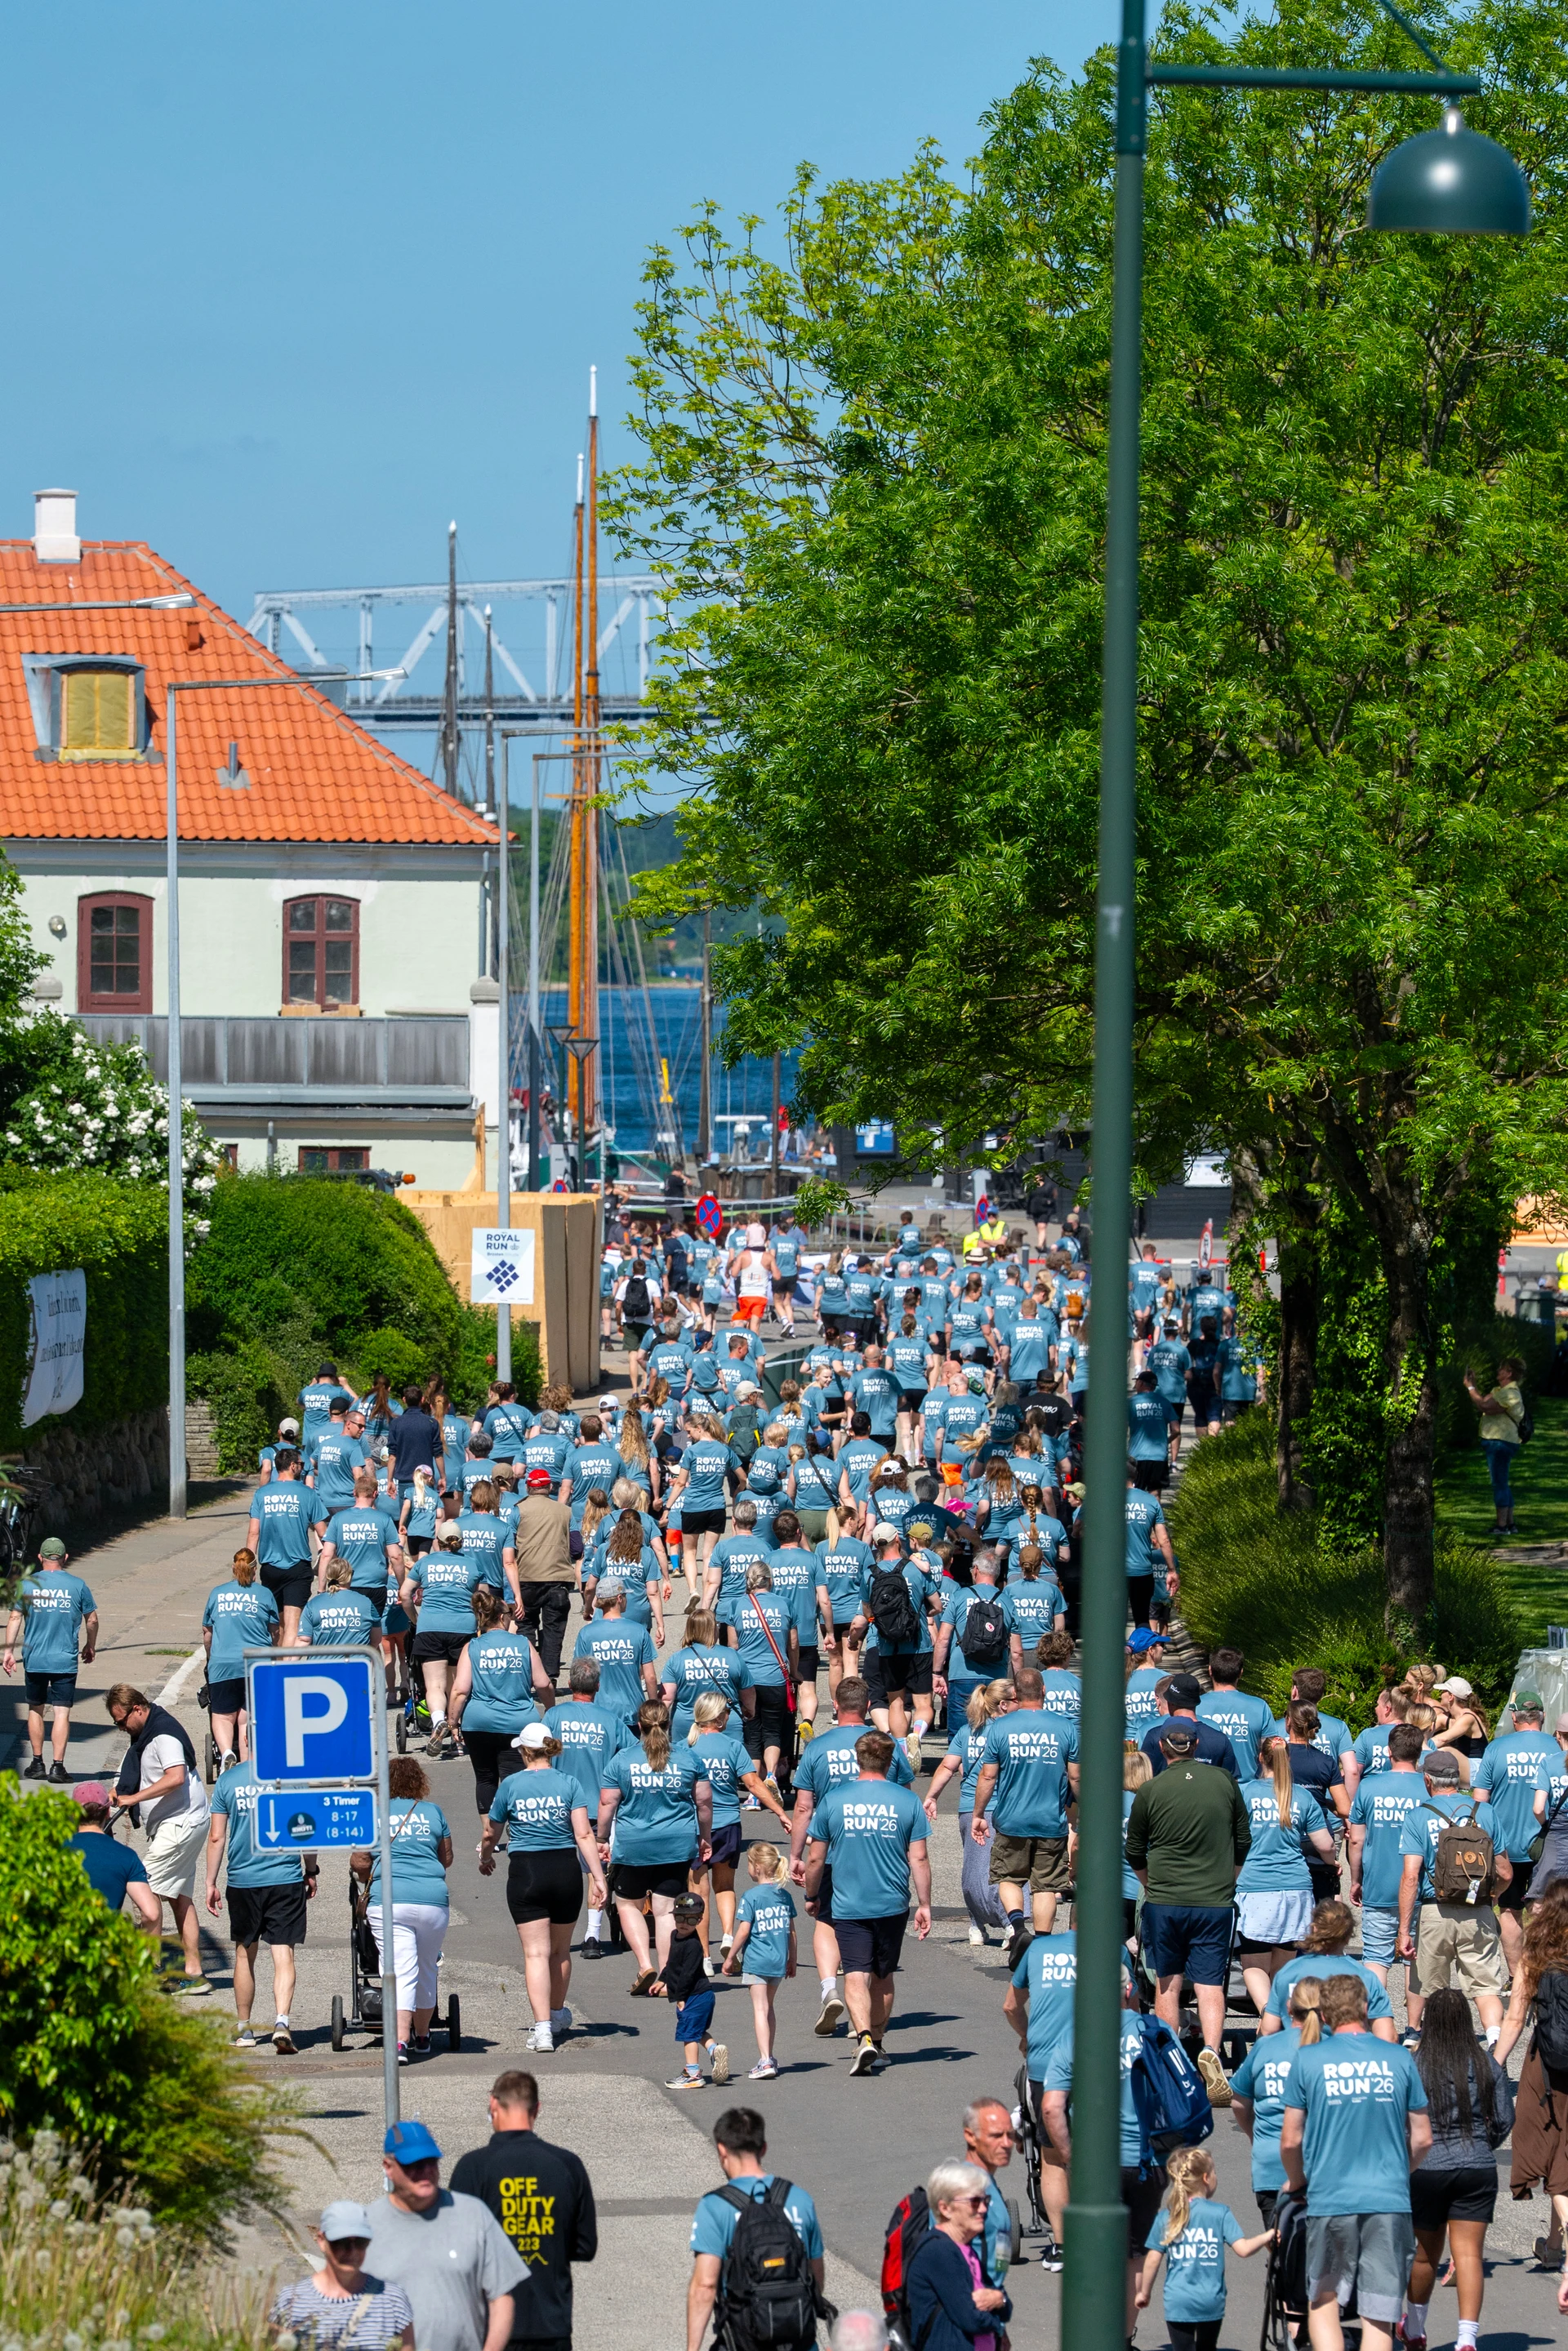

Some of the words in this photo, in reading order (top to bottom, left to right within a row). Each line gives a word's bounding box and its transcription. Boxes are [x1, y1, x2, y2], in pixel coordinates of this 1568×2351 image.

[657, 1356, 684, 1364] ROYAL
[720, 1369, 741, 1377] OYAL
[996, 1413, 1015, 1422] OYAL
[322, 1446, 341, 1454] ROYAL
[526, 1447, 555, 1456] ROYAL
[321, 1454, 341, 1462] RUN'26
[527, 1454, 555, 1463] RUN'26
[849, 1454, 877, 1463] ROYAL
[581, 1459, 612, 1468] ROYAL
[581, 1467, 612, 1476] RUN'26
[1014, 1472, 1037, 1481] OYAL
[265, 1495, 299, 1504] ROYAL
[878, 1499, 910, 1508] ROYAL
[265, 1503, 299, 1512] RUN'26
[905, 1514, 937, 1522] ROYAL
[343, 1523, 378, 1532] ROYAL
[343, 1532, 377, 1540] RUN'26
[463, 1530, 497, 1539] ROYAL
[463, 1538, 496, 1547] RUN'26
[825, 1556, 858, 1565] ROYAL
[428, 1565, 469, 1574] ROYAL
[608, 1566, 643, 1577] RUN'26
[773, 1566, 808, 1576] ROYAL
[826, 1565, 858, 1574] RUN'26
[428, 1574, 468, 1583] RUN'26
[774, 1576, 808, 1585] RUN'26
[33, 1589, 71, 1598] ROYAL
[218, 1593, 258, 1603] ROYAL
[33, 1599, 70, 1608] RUN'26
[218, 1602, 257, 1613] RUN'26
[1014, 1599, 1049, 1609] ROYAL
[319, 1607, 361, 1618] ROYAL
[1017, 1608, 1049, 1617] RUN'26
[322, 1617, 360, 1627] RUN'26
[592, 1640, 633, 1650] ROYAL
[480, 1647, 522, 1658] ROYAL
[594, 1650, 634, 1660] RUN'26
[479, 1658, 522, 1668] RUN'26
[685, 1658, 728, 1668] ROYAL
[685, 1668, 728, 1680] RUN'26
[1125, 1691, 1155, 1702] ROYA
[283, 1676, 348, 1767] P
[561, 1721, 604, 1734] ROYAL
[1223, 1725, 1248, 1735] N'26
[562, 1733, 603, 1745] RUN'26
[1008, 1733, 1058, 1745] ROYAL
[826, 1749, 858, 1762] ROY
[1009, 1746, 1058, 1757] RUN'26
[1507, 1752, 1547, 1764] ROY
[702, 1758, 729, 1769] YAL
[708, 1770, 728, 1780] N'26
[632, 1776, 681, 1788] RUN'26
[323, 1797, 330, 1806] 3
[333, 1797, 360, 1806] Timer
[515, 1796, 565, 1809] ROYAL
[518, 1808, 567, 1822] RUN'26
[843, 1803, 898, 1818] ROYAL
[390, 1814, 429, 1826] OYAL
[844, 1818, 897, 1831] RUN'26
[390, 1824, 430, 1837] UN'26
[758, 1919, 791, 1932] RUN'2
[1043, 1953, 1076, 1966] ROY
[1323, 2061, 1393, 2079] ROYAL
[1325, 2077, 1394, 2097] RUN'26
[499, 2177, 537, 2197] OFF
[501, 2197, 555, 2216] DUTY
[503, 2216, 555, 2235] GEAR
[518, 2237, 541, 2251] 223
